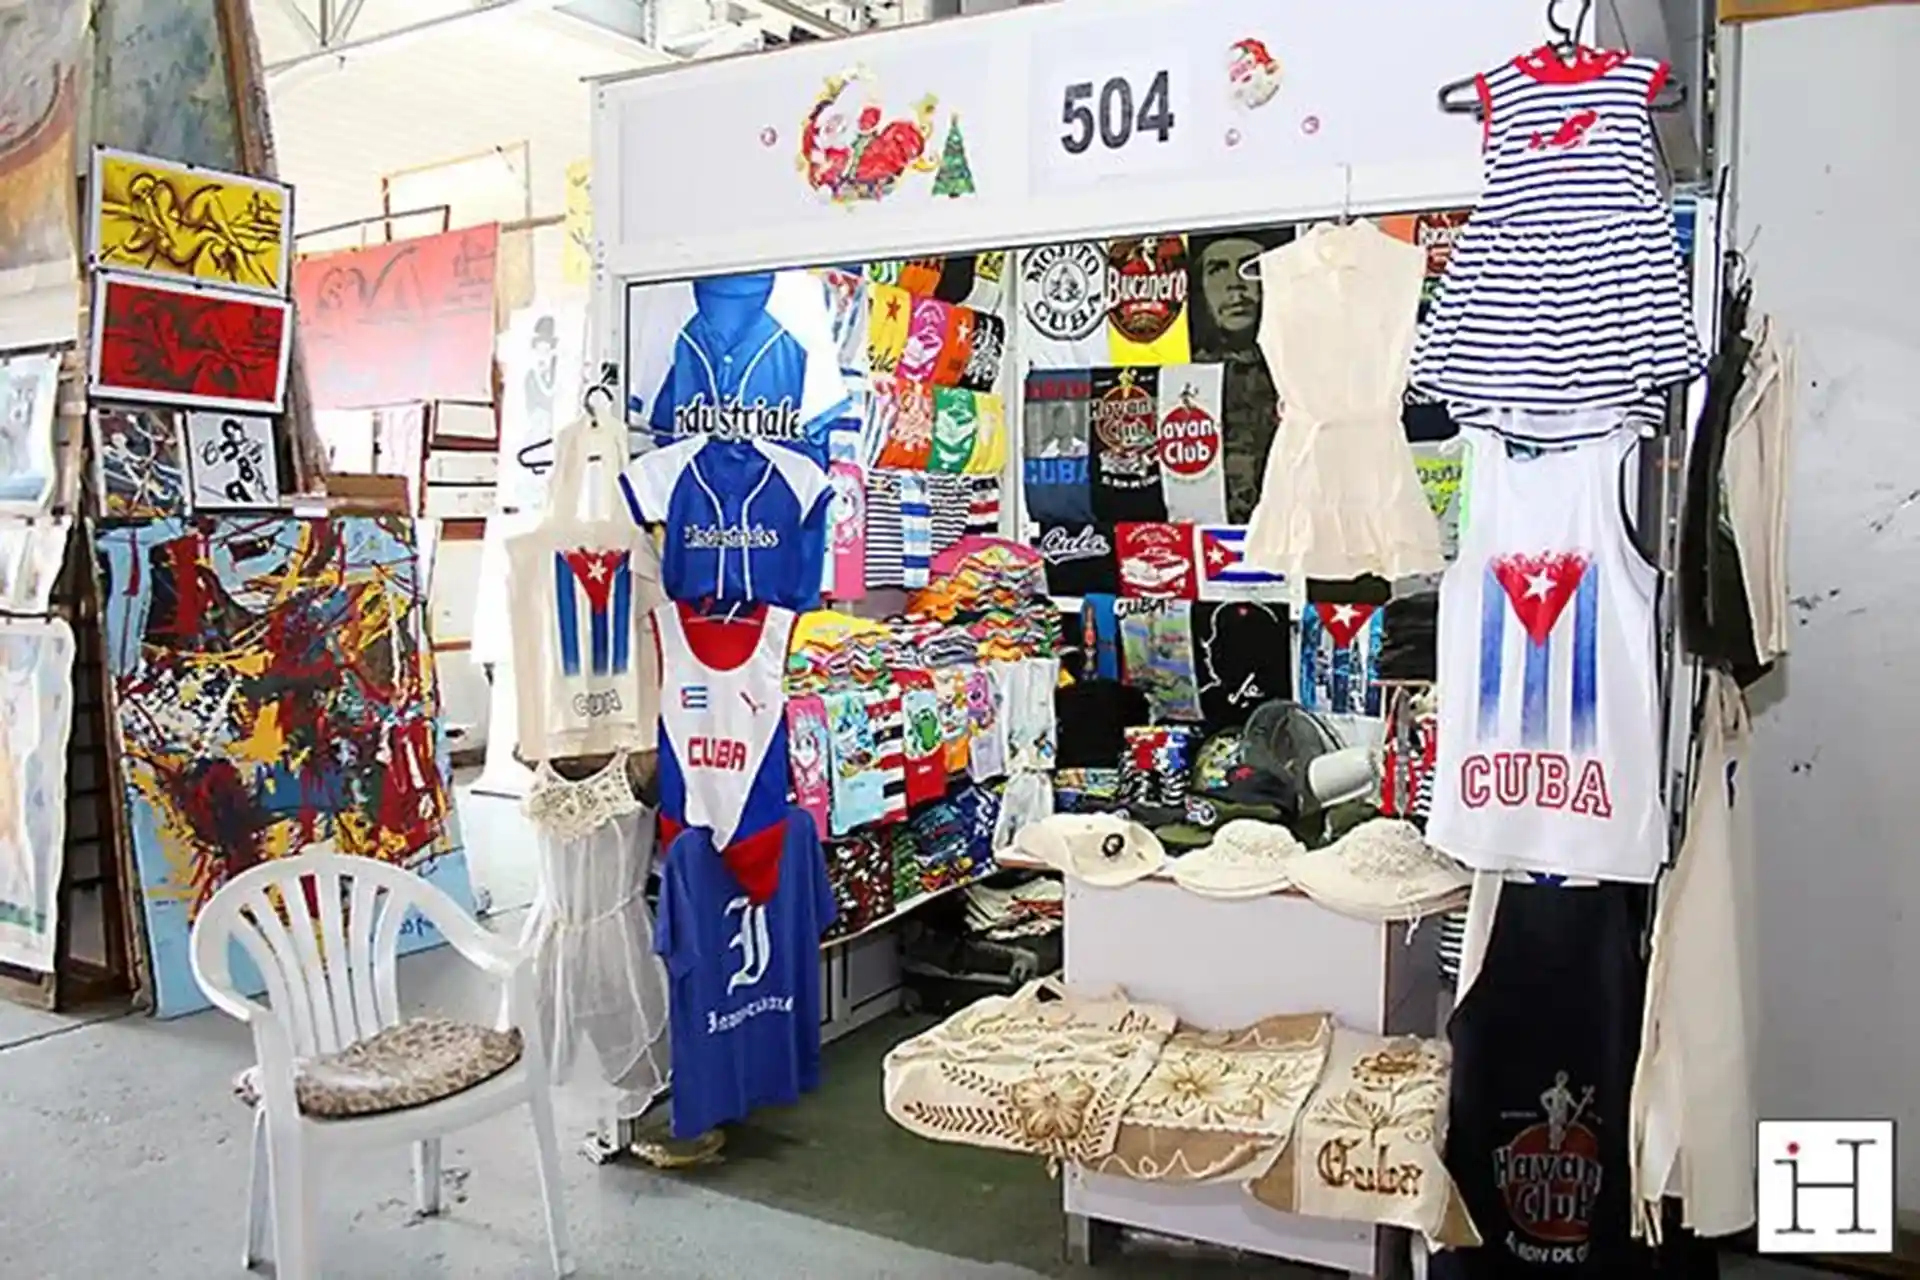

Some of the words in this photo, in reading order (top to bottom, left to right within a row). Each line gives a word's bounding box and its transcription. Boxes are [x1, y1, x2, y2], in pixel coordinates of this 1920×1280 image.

[1061, 70, 1174, 154] 504
[1025, 244, 1100, 283] MOJITO
[1106, 266, 1188, 309] Bucanero
[1033, 293, 1101, 332] CUBA
[1165, 440, 1211, 464] Club
[1039, 524, 1113, 560] Cuba
[1113, 596, 1166, 621] CUBA
[688, 736, 747, 772] CUBA
[1461, 753, 1612, 819] CUBA
[1317, 1136, 1423, 1197] Cuba
